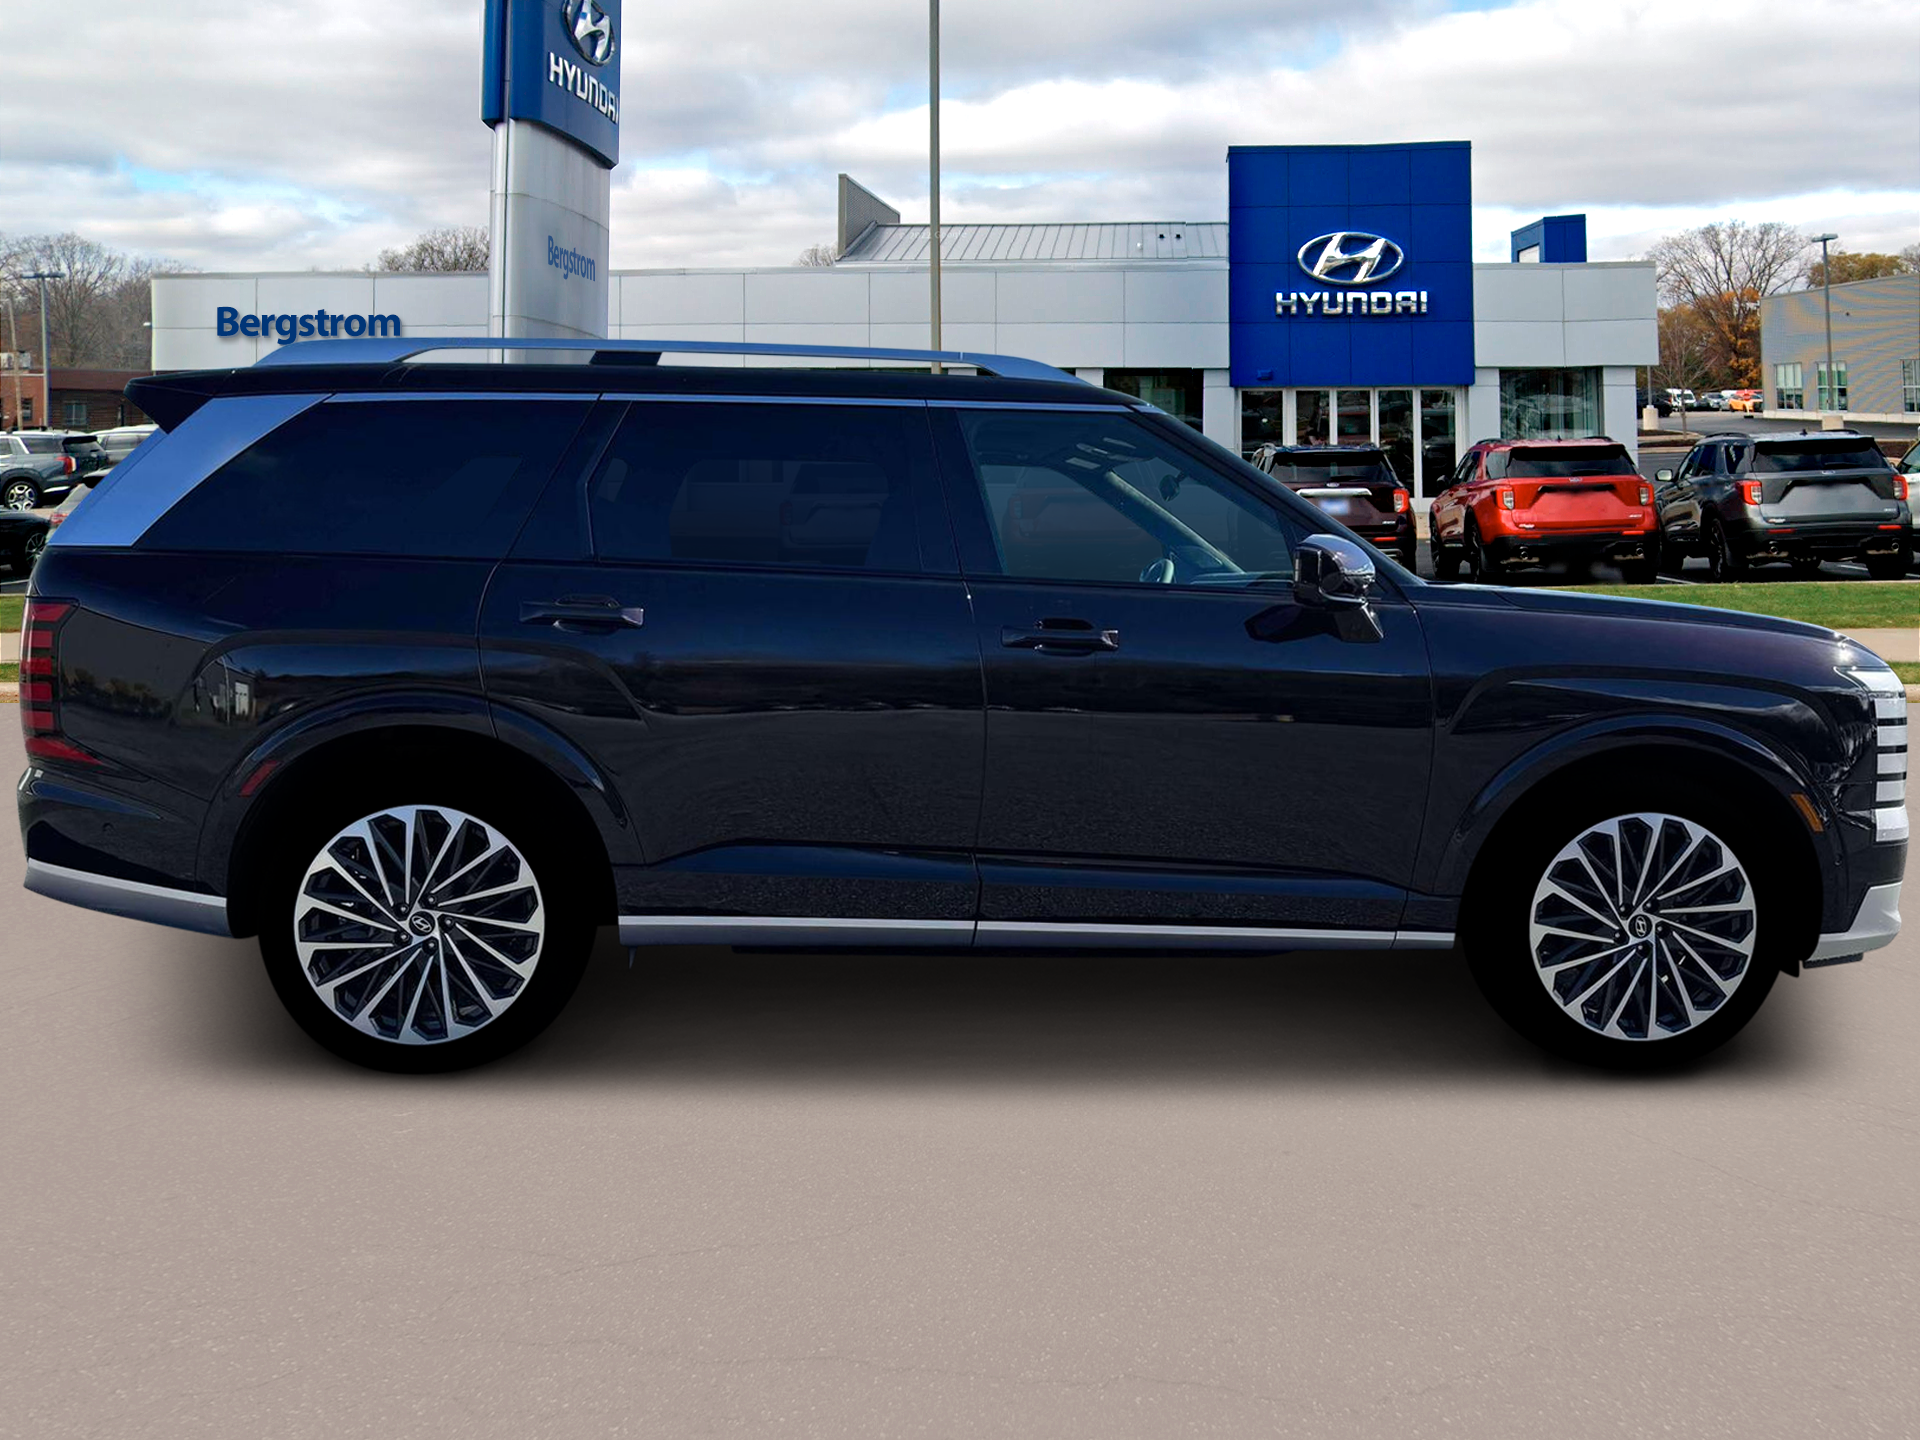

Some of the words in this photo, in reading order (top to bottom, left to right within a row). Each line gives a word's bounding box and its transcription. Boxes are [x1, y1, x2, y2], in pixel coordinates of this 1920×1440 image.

[549, 52, 619, 125] HYUNDAI
[548, 235, 596, 282] Bergstrom
[1275, 291, 1428, 315] HYUNDAI
[216, 306, 401, 345] Bergstrom
